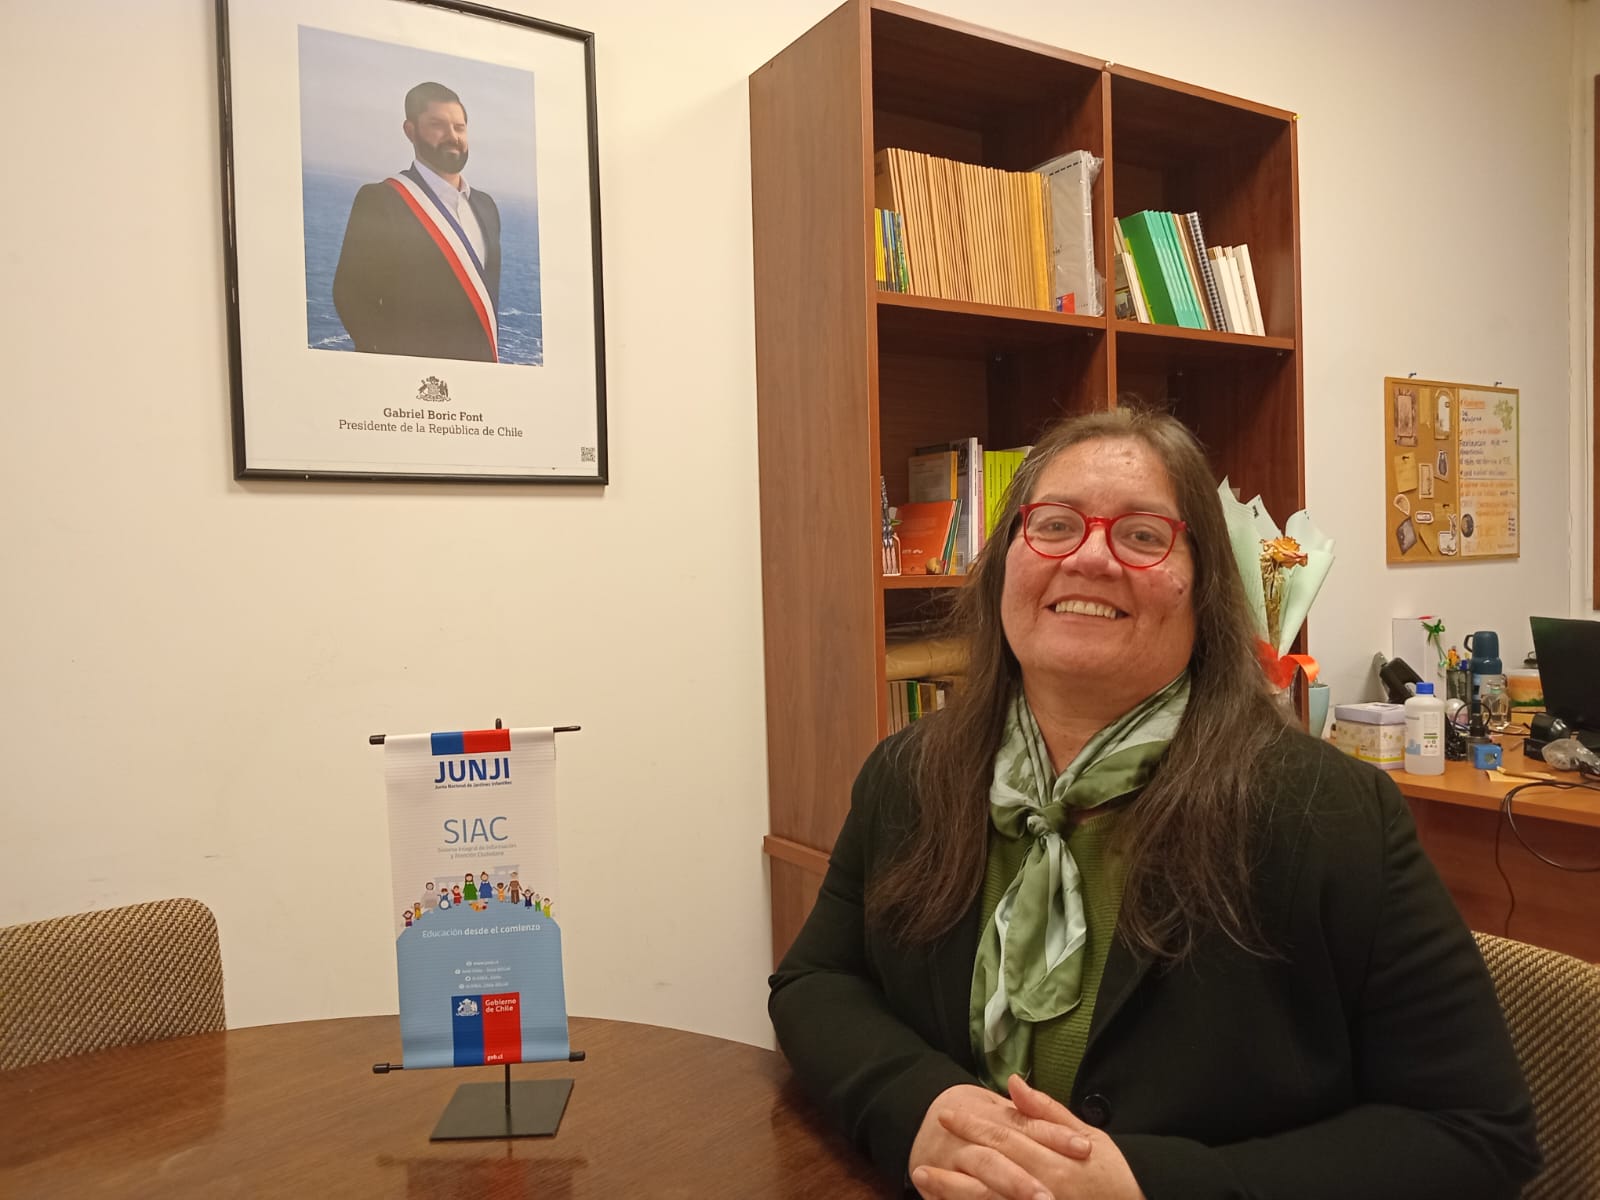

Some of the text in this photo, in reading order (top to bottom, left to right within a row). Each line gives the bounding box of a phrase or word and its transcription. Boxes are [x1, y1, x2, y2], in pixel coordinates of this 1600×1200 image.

[383, 407, 484, 422] Gabriel Boric Font
[338, 419, 523, 437] Presidente de la República de Chile
[434, 758, 510, 783] JUNJI
[443, 816, 509, 844] SIAC
[422, 923, 541, 938] Educación desde el comienzo
[485, 998, 517, 1007] Gobierno
[495, 1004, 514, 1013] Chile
[487, 1053, 504, 1062] gob.cl
